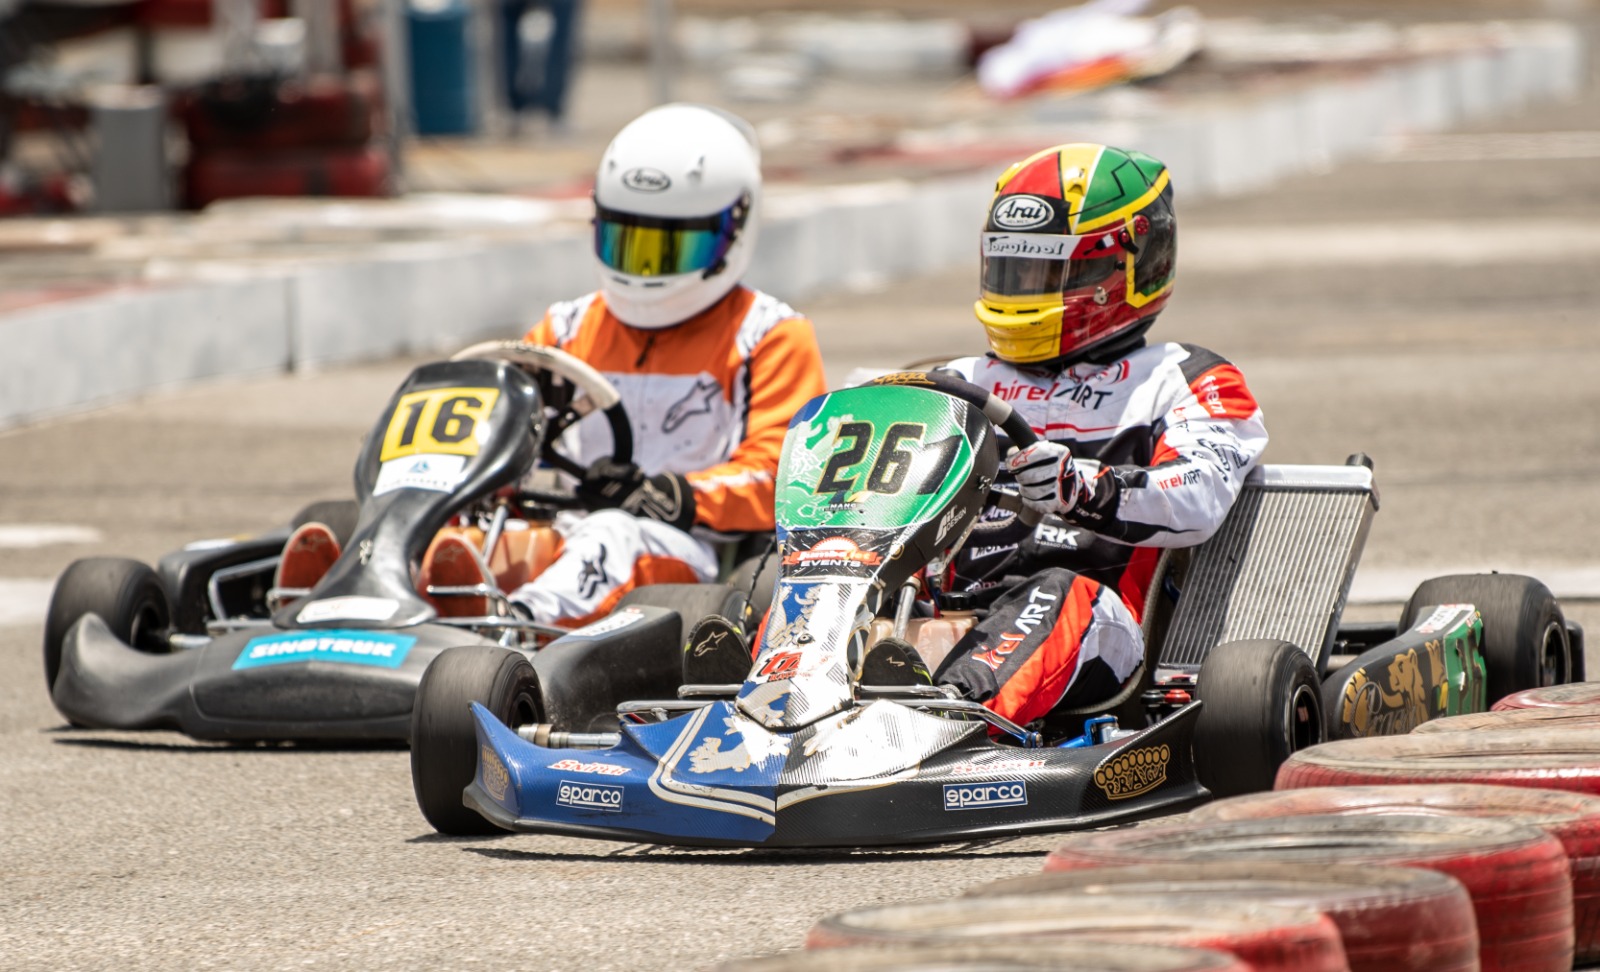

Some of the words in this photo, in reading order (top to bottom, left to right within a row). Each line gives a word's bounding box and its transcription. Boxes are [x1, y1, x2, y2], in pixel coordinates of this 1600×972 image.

[996, 200, 1045, 219] Arai
[398, 396, 483, 447] 16
[813, 420, 929, 495] 26
[1034, 522, 1080, 546] RK
[801, 559, 861, 568] EVENTS
[249, 637, 397, 659] SINOTRUK
[559, 785, 622, 807] sparco
[945, 784, 1025, 807] sparco
